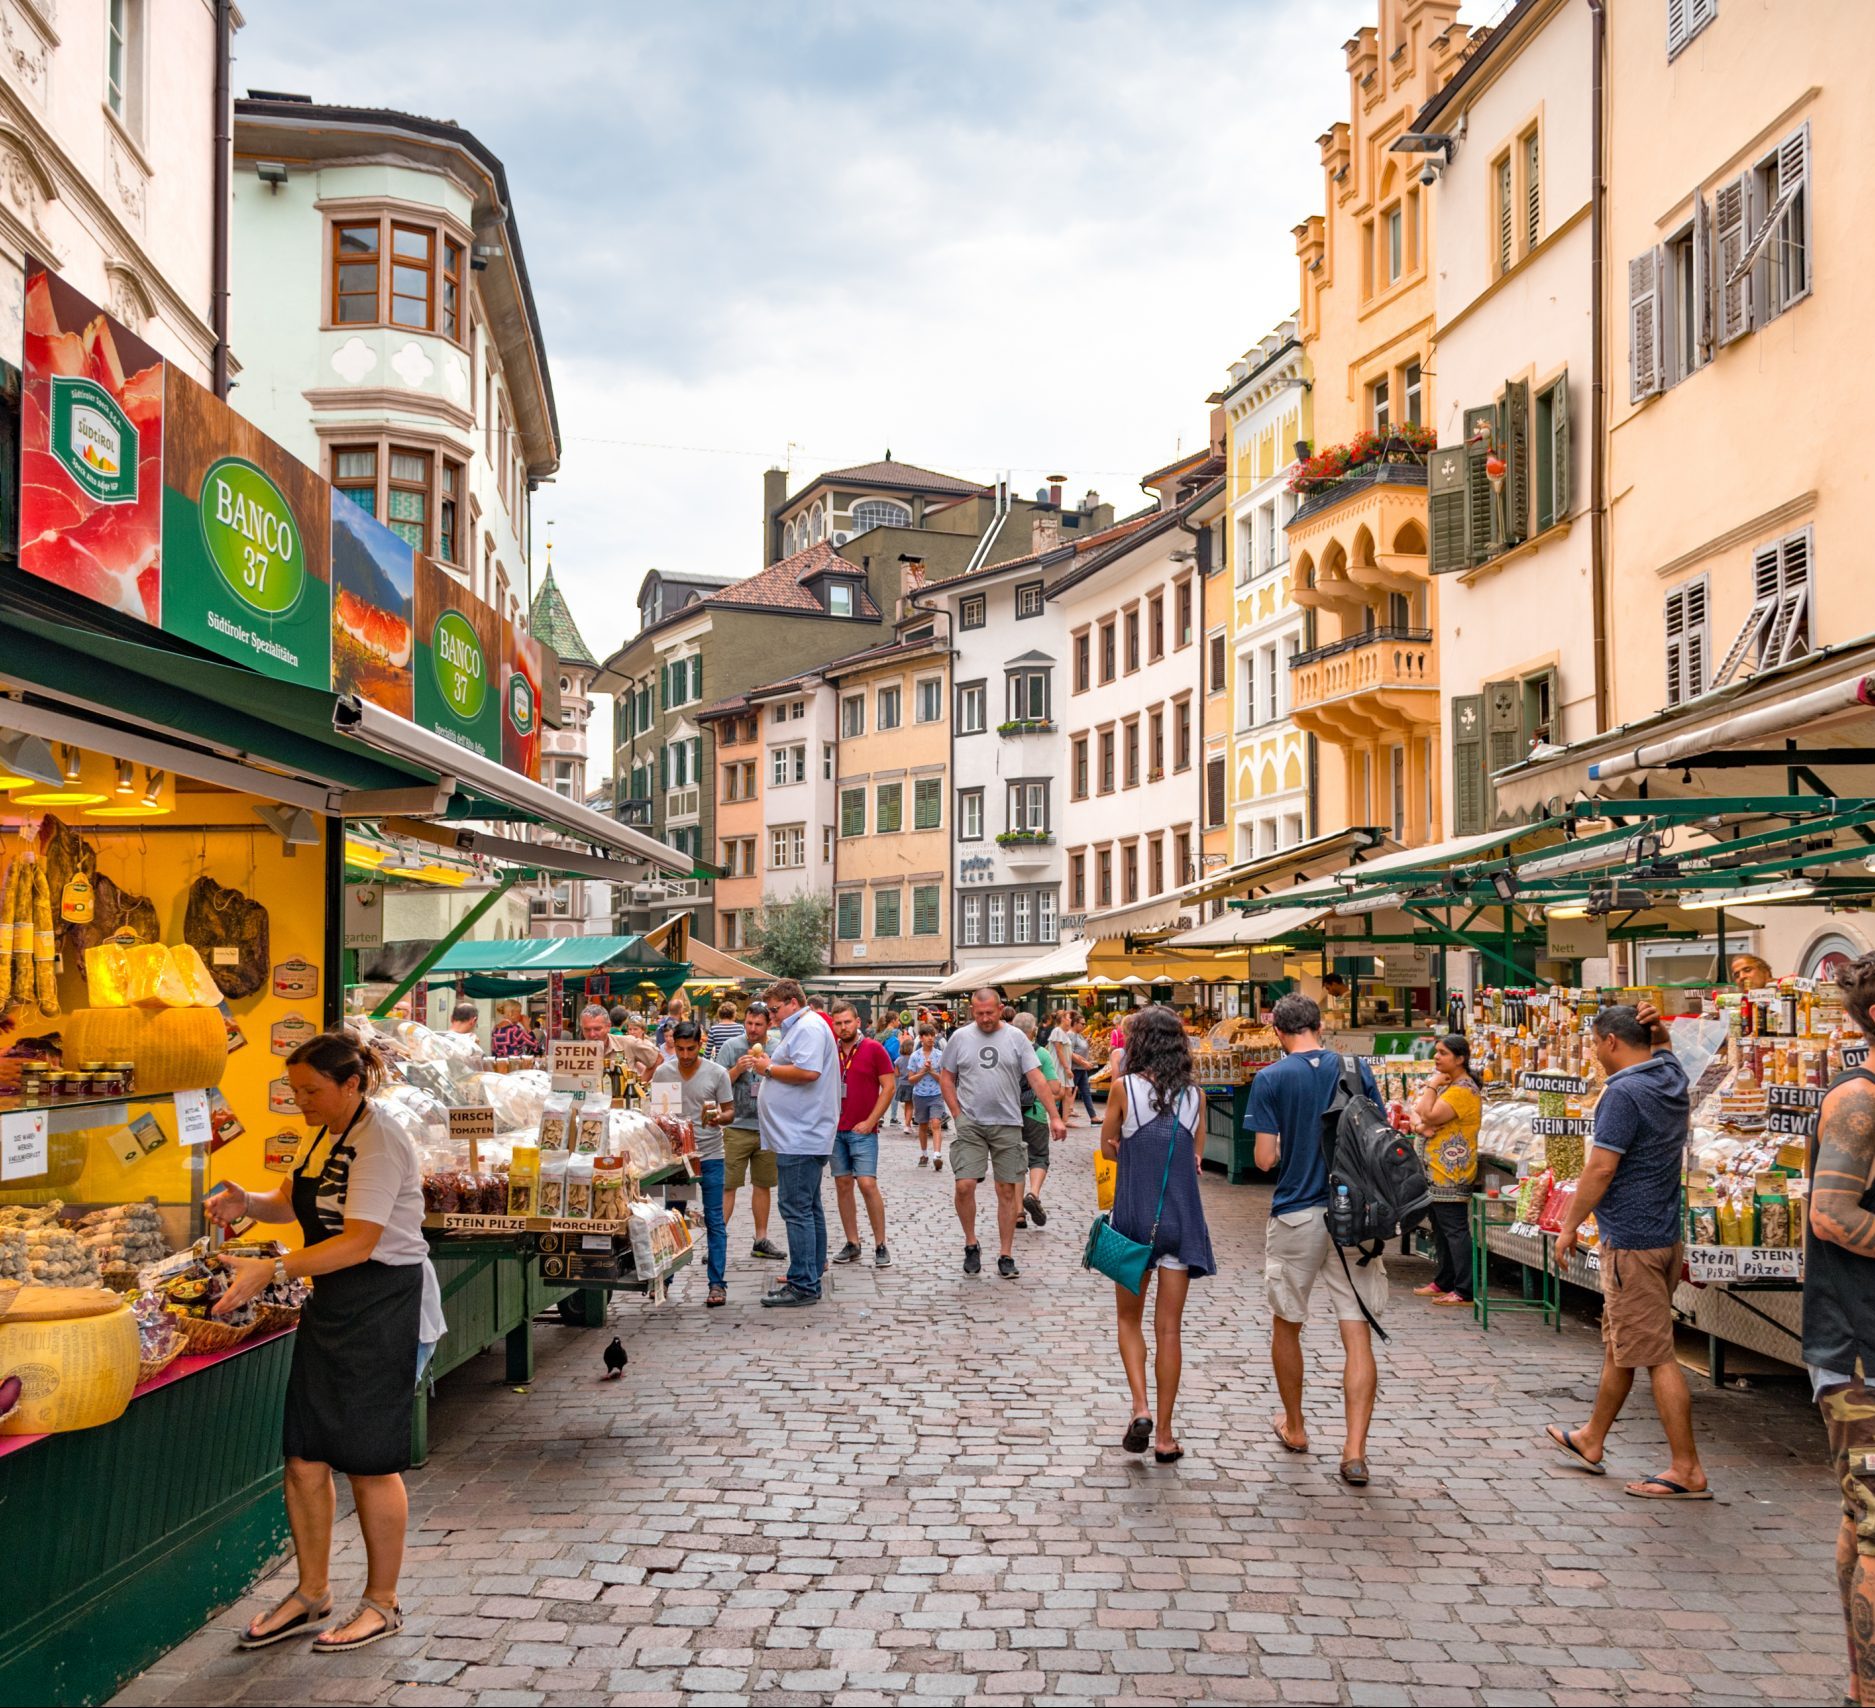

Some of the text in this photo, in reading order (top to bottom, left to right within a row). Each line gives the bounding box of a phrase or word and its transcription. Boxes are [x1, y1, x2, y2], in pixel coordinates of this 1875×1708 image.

[216, 478, 292, 561] BANCO
[243, 546, 269, 592] 37
[208, 610, 299, 667] Südtiroler Spezialitäten
[440, 627, 480, 679] BANCO
[454, 672, 468, 704] 37
[1552, 944, 1576, 953] Nett
[555, 1046, 598, 1057] STEIN
[979, 1046, 999, 1069] 9
[555, 1060, 595, 1071] PILZE
[1524, 1077, 1586, 1094] MORCHELN
[450, 1112, 494, 1122] KIRSCH
[451, 1127, 494, 1135] TOMATEN
[1533, 1118, 1596, 1135] STEIN PILZE
[446, 1217, 525, 1230] STEIN PILZE
[552, 1221, 618, 1231] MORCHELN
[1691, 1250, 1734, 1266] Stein
[1751, 1250, 1793, 1261] STEIN
[1706, 1267, 1737, 1279] Pilze
[1743, 1262, 1780, 1275] Pilze
